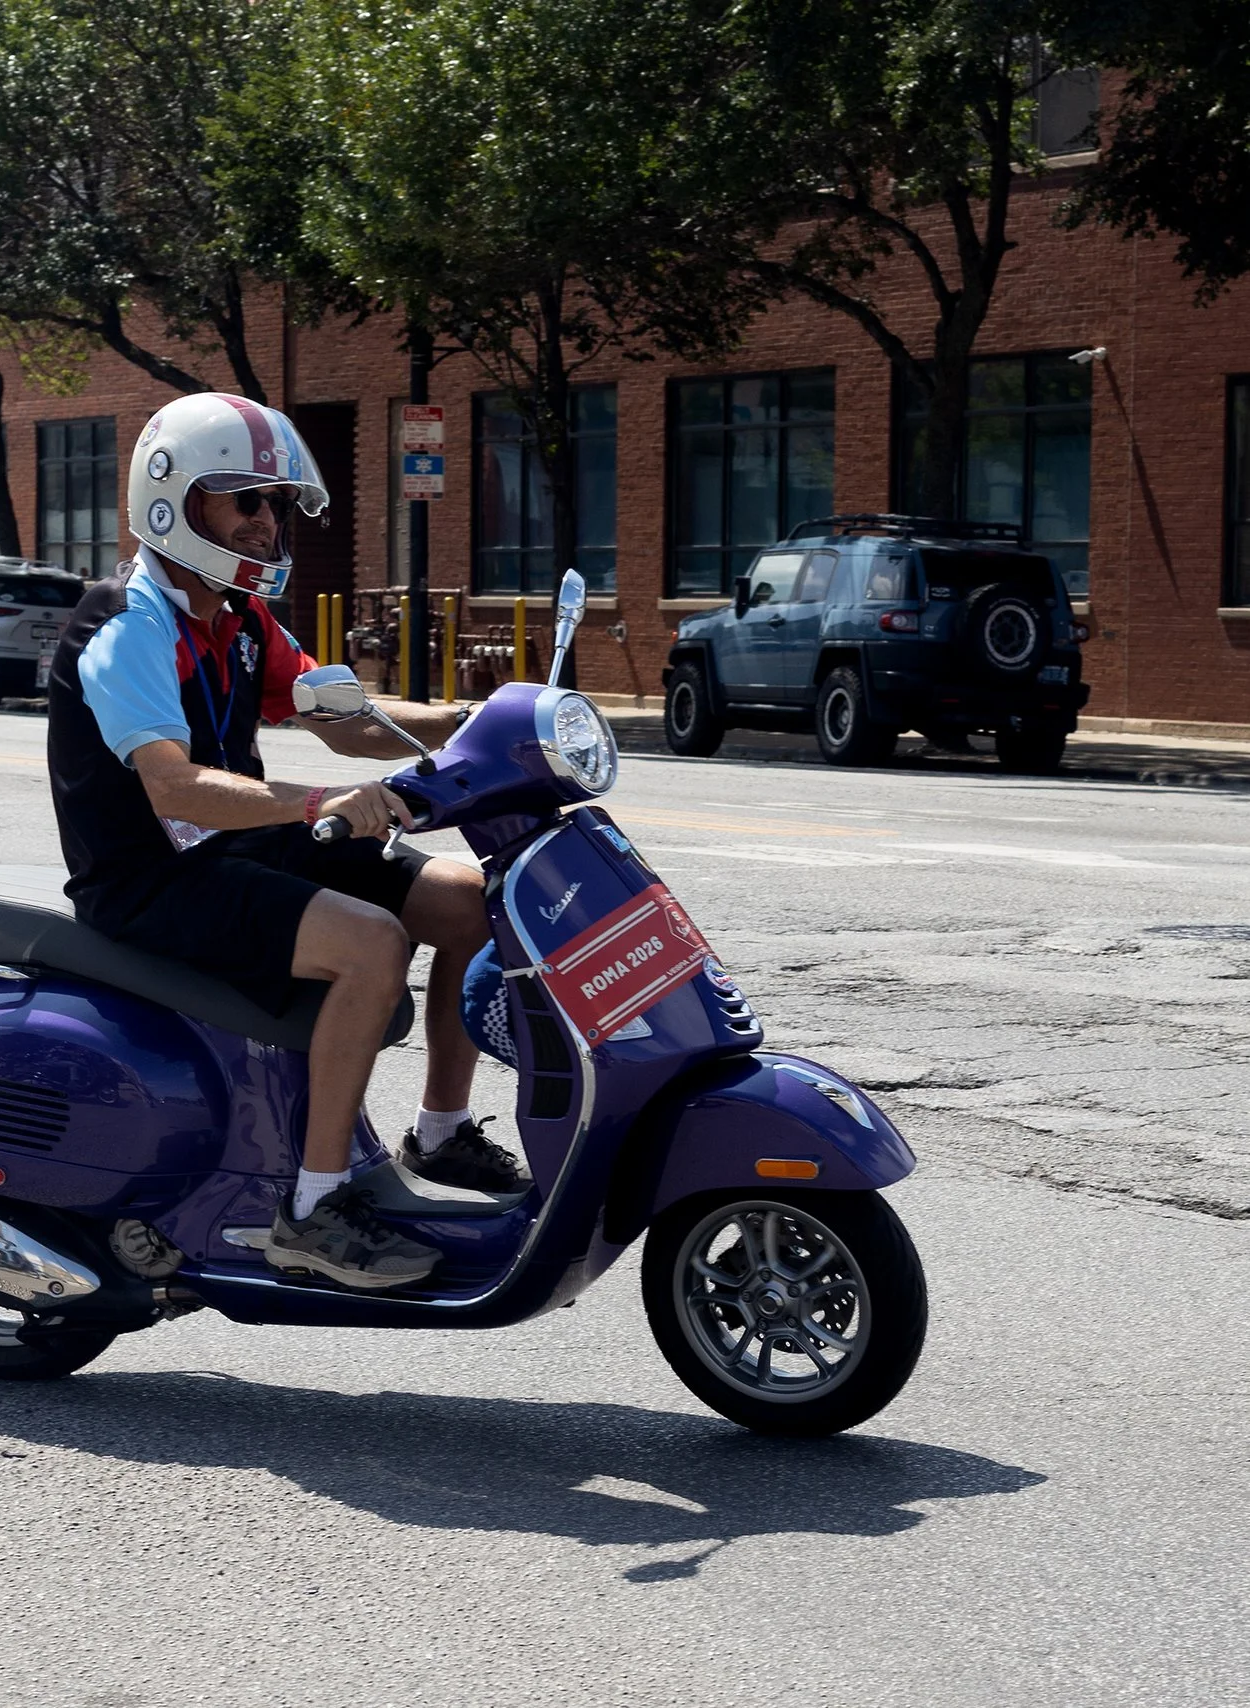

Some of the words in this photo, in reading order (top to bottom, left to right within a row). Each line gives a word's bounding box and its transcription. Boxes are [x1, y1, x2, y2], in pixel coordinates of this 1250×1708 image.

[538, 881, 582, 925] Vespa
[580, 960, 630, 1000] ROMA
[626, 936, 664, 968] 2026
